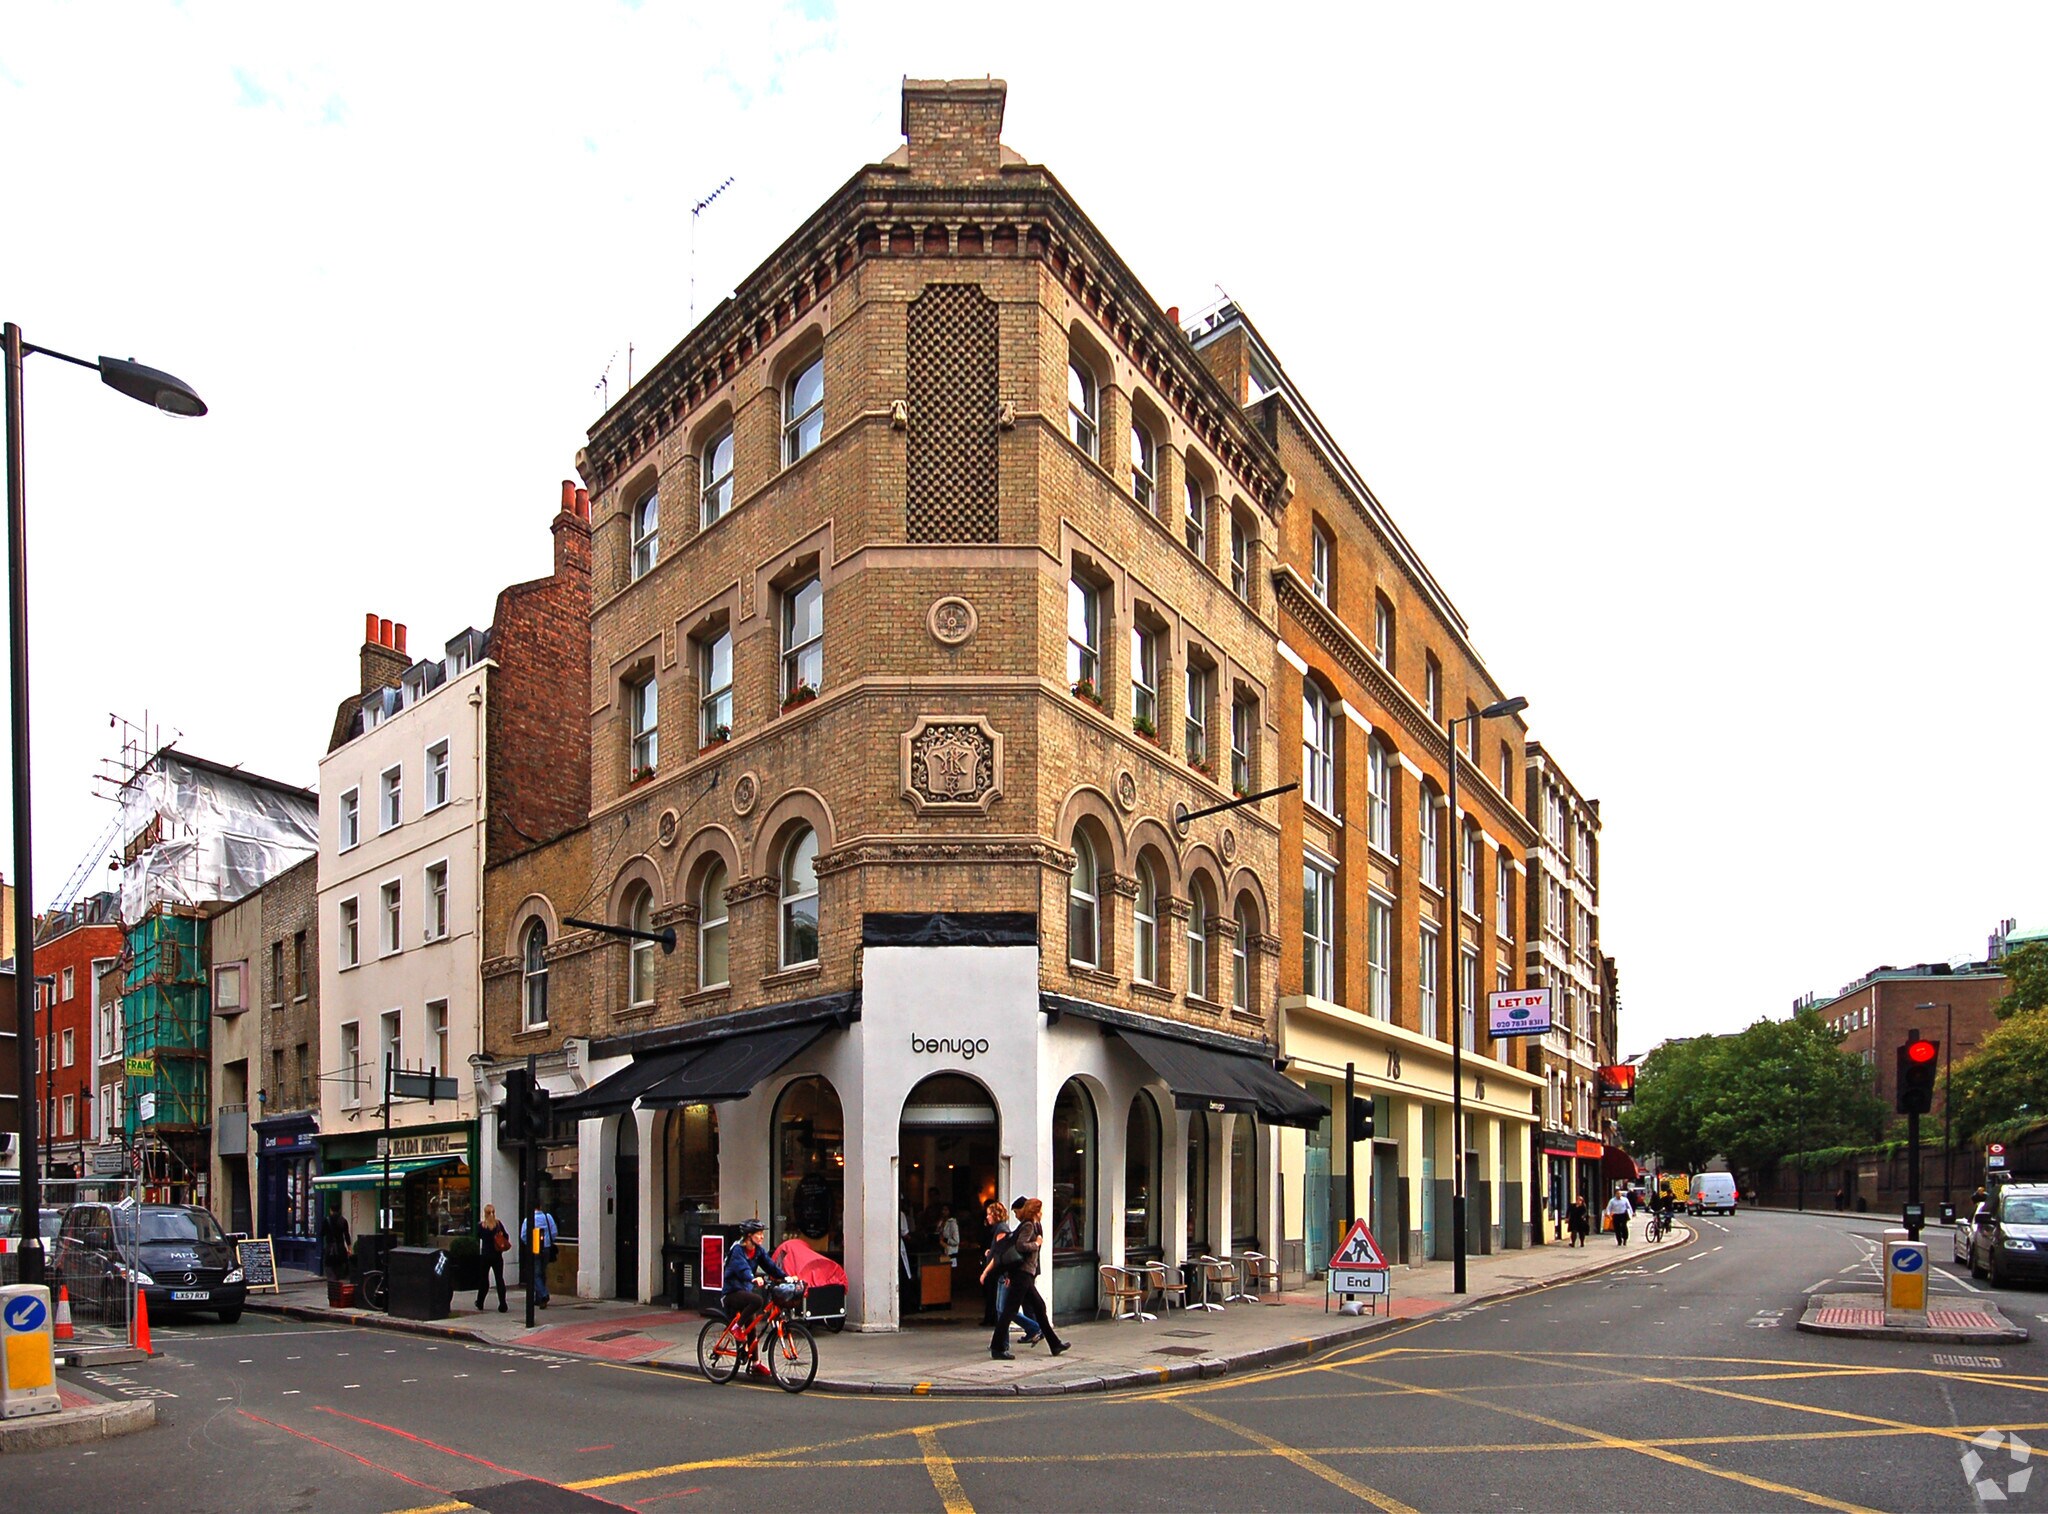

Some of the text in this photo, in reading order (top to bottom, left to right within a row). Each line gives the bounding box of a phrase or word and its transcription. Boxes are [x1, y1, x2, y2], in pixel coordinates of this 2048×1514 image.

[1497, 995, 1543, 1008] LET BY
[911, 1032, 990, 1060] benugo
[1385, 1047, 1401, 1080] 78
[1346, 1276, 1371, 1288] End
